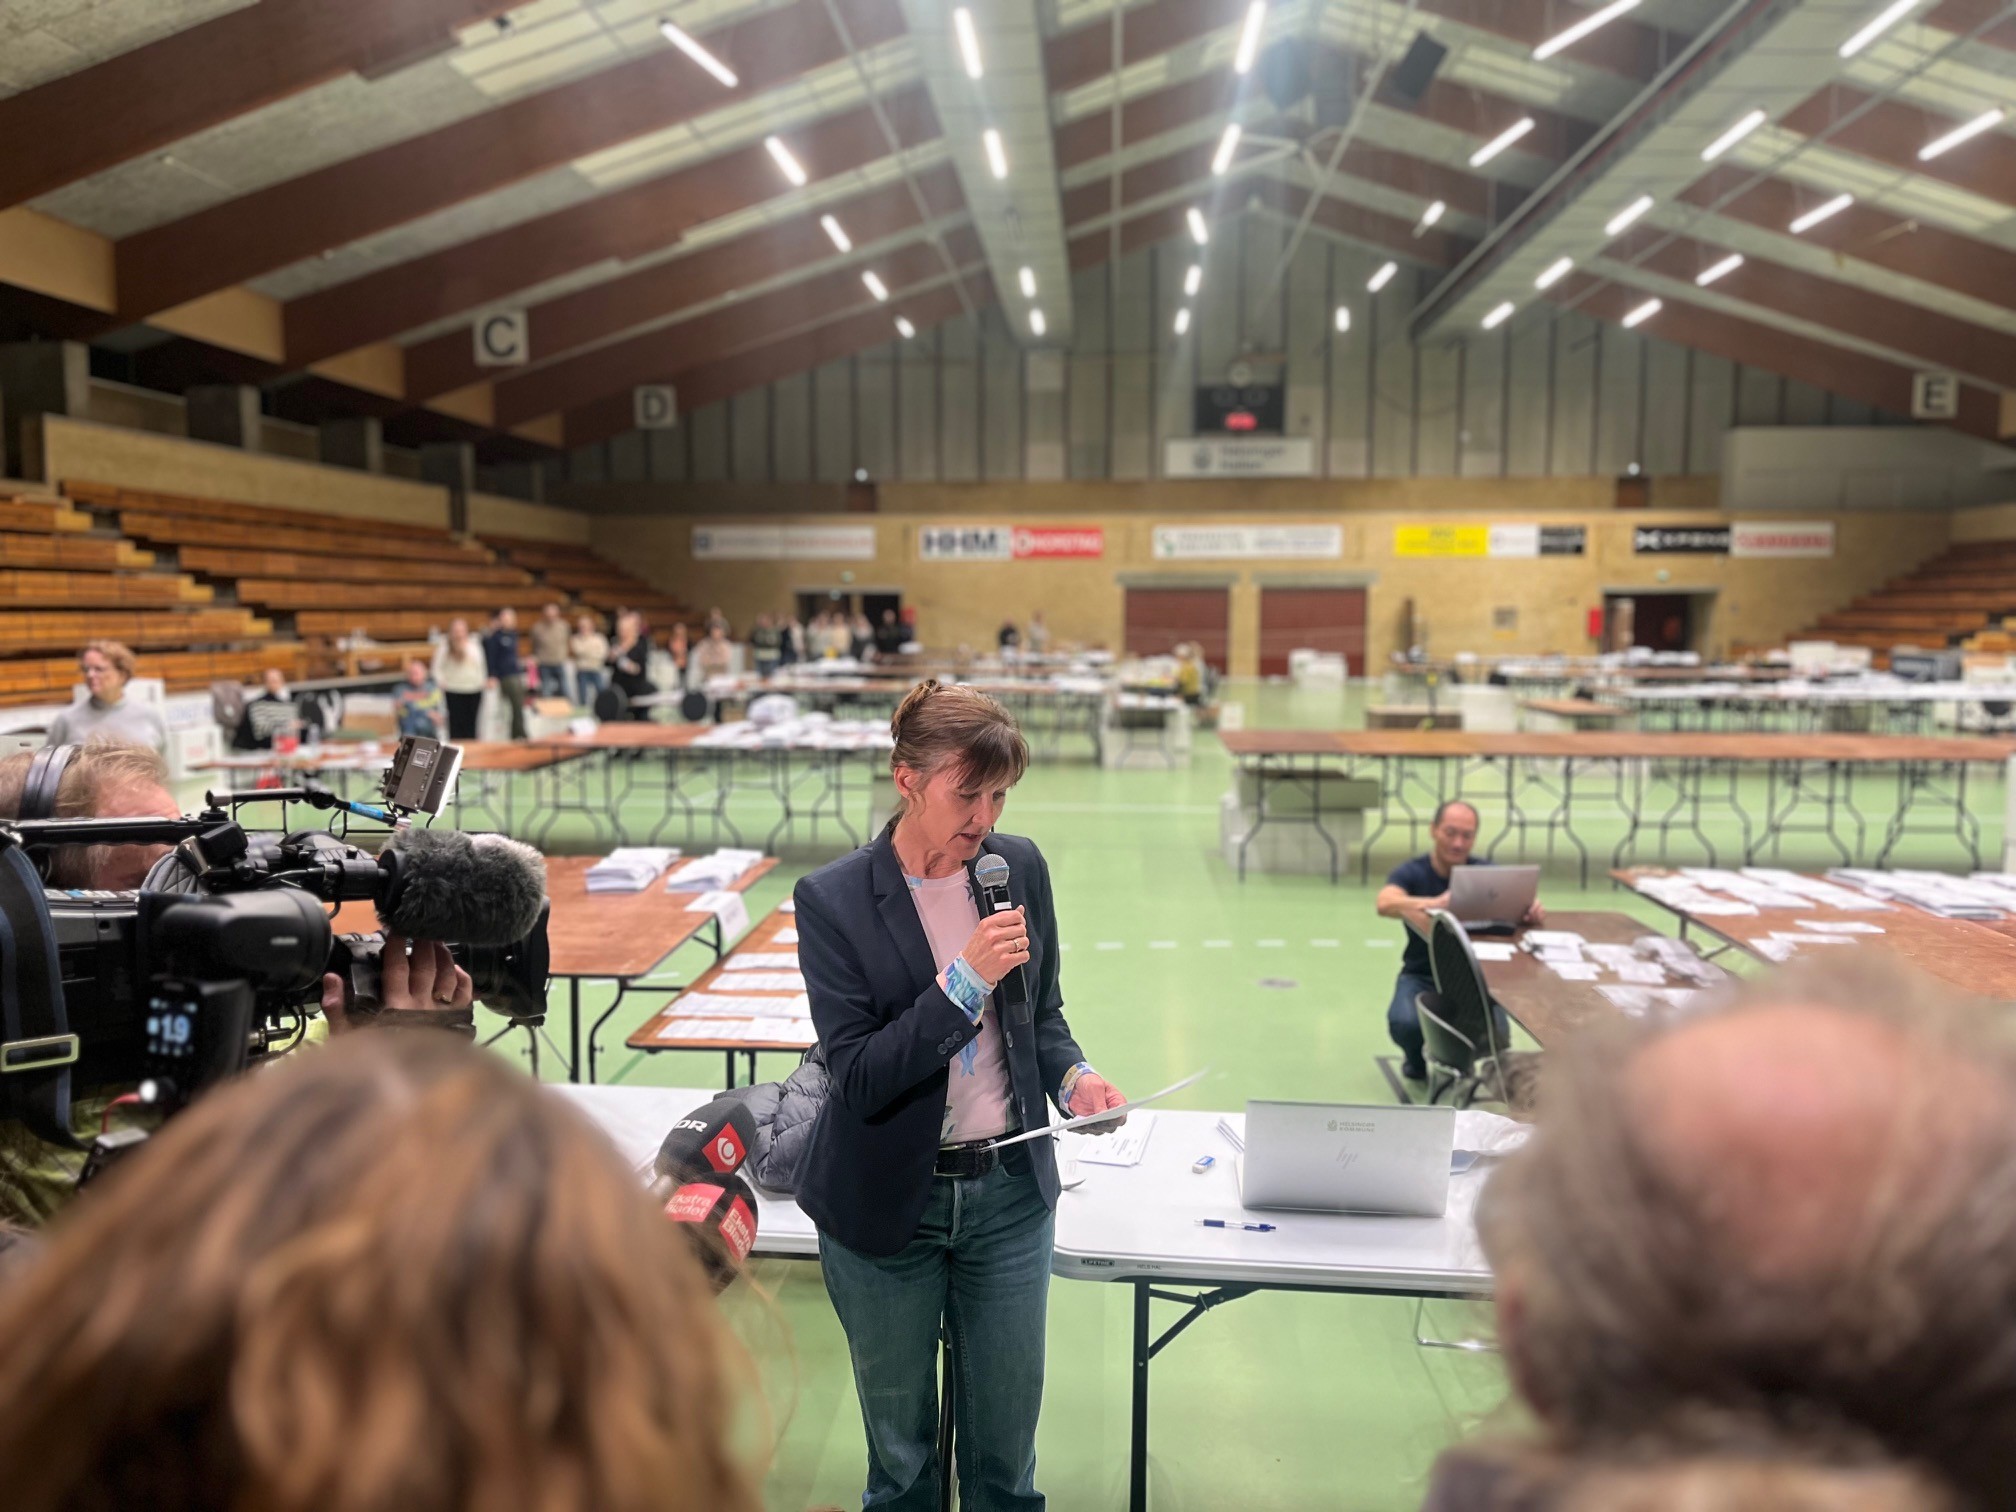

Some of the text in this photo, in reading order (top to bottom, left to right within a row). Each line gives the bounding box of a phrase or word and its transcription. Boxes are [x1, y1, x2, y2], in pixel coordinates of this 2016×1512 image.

[484, 316, 515, 358] C
[642, 389, 668, 421] D
[1924, 378, 1947, 411] E
[673, 1118, 708, 1133] DR
[671, 1193, 712, 1208] Ekstra
